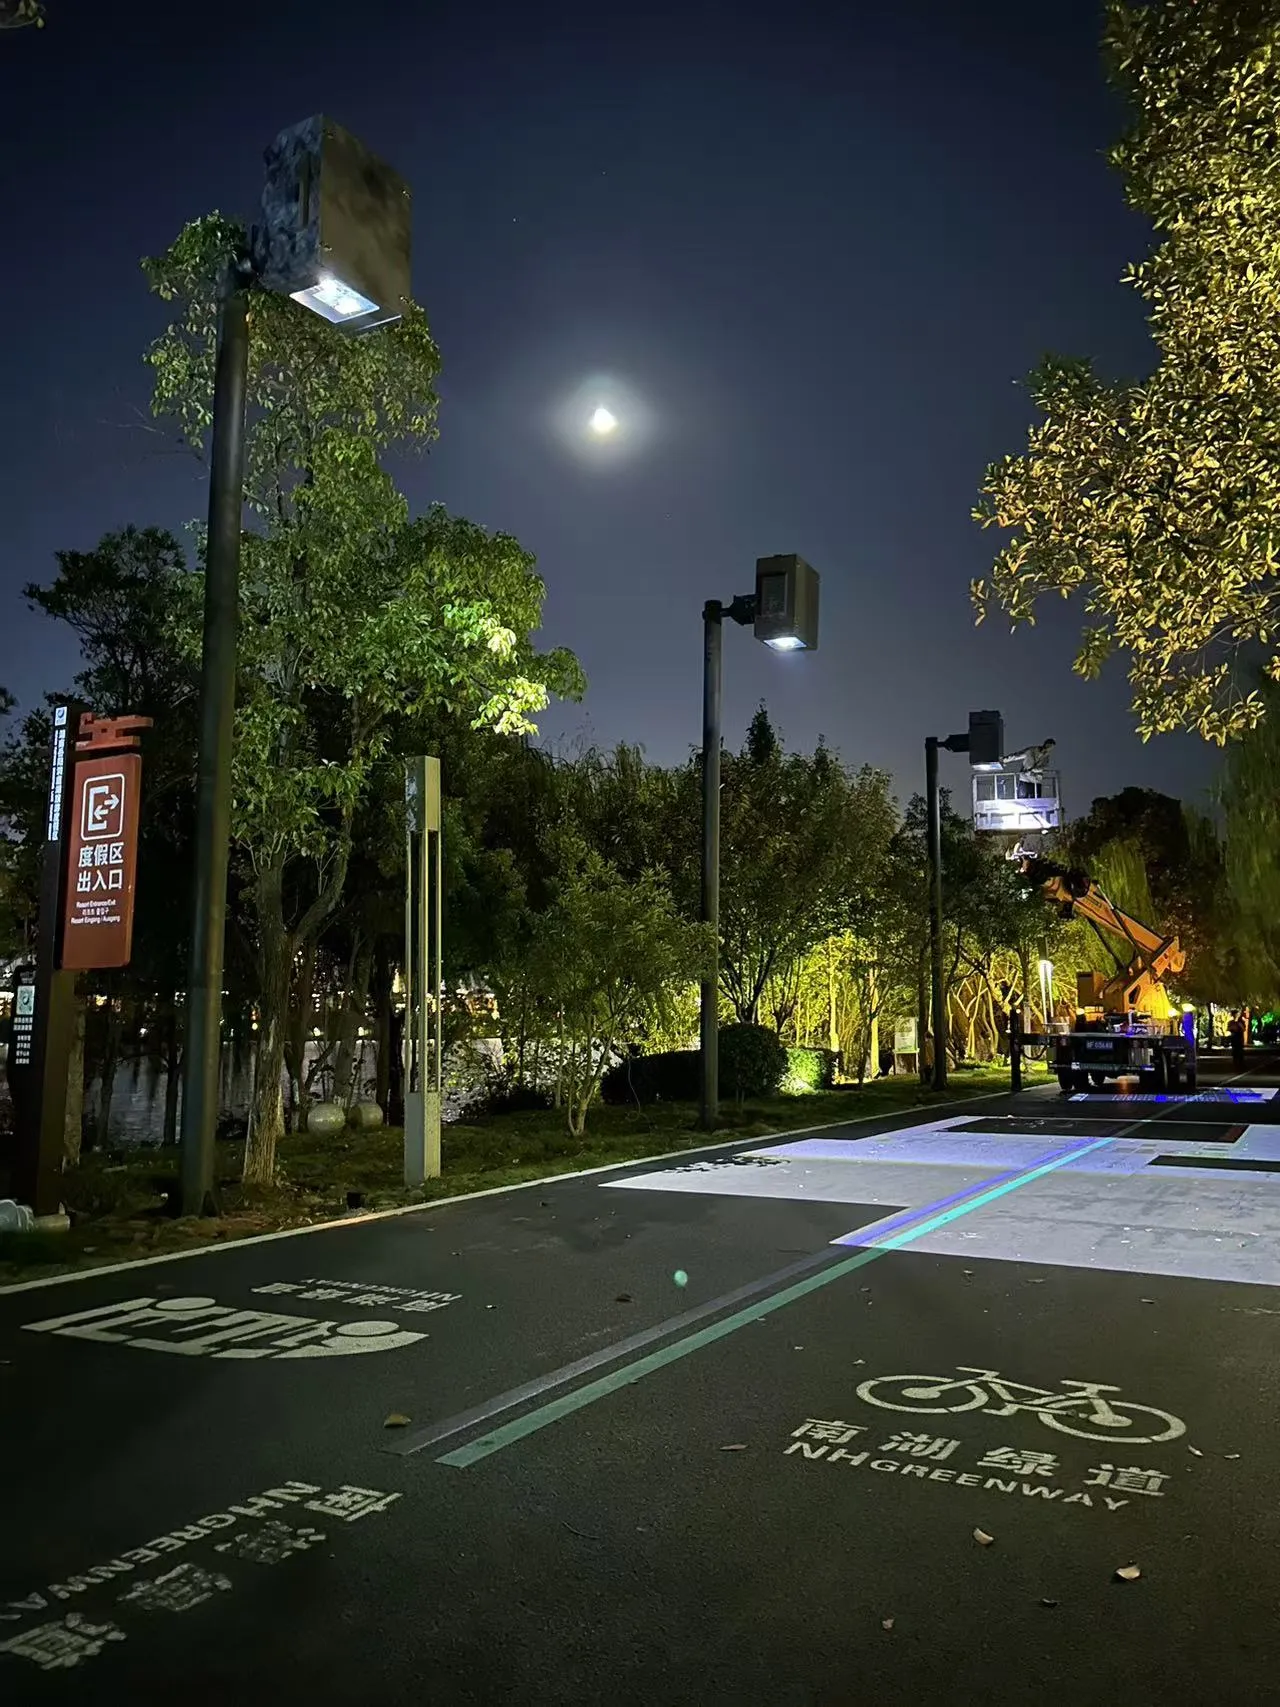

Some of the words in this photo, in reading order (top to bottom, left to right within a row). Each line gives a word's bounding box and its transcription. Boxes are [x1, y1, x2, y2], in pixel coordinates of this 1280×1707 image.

[78, 842, 124, 868] 度假区
[76, 869, 123, 893] 出入口
[783, 1442, 1129, 1511] NHGREENWAY
[789, 1418, 1172, 1496] 南湖绿道
